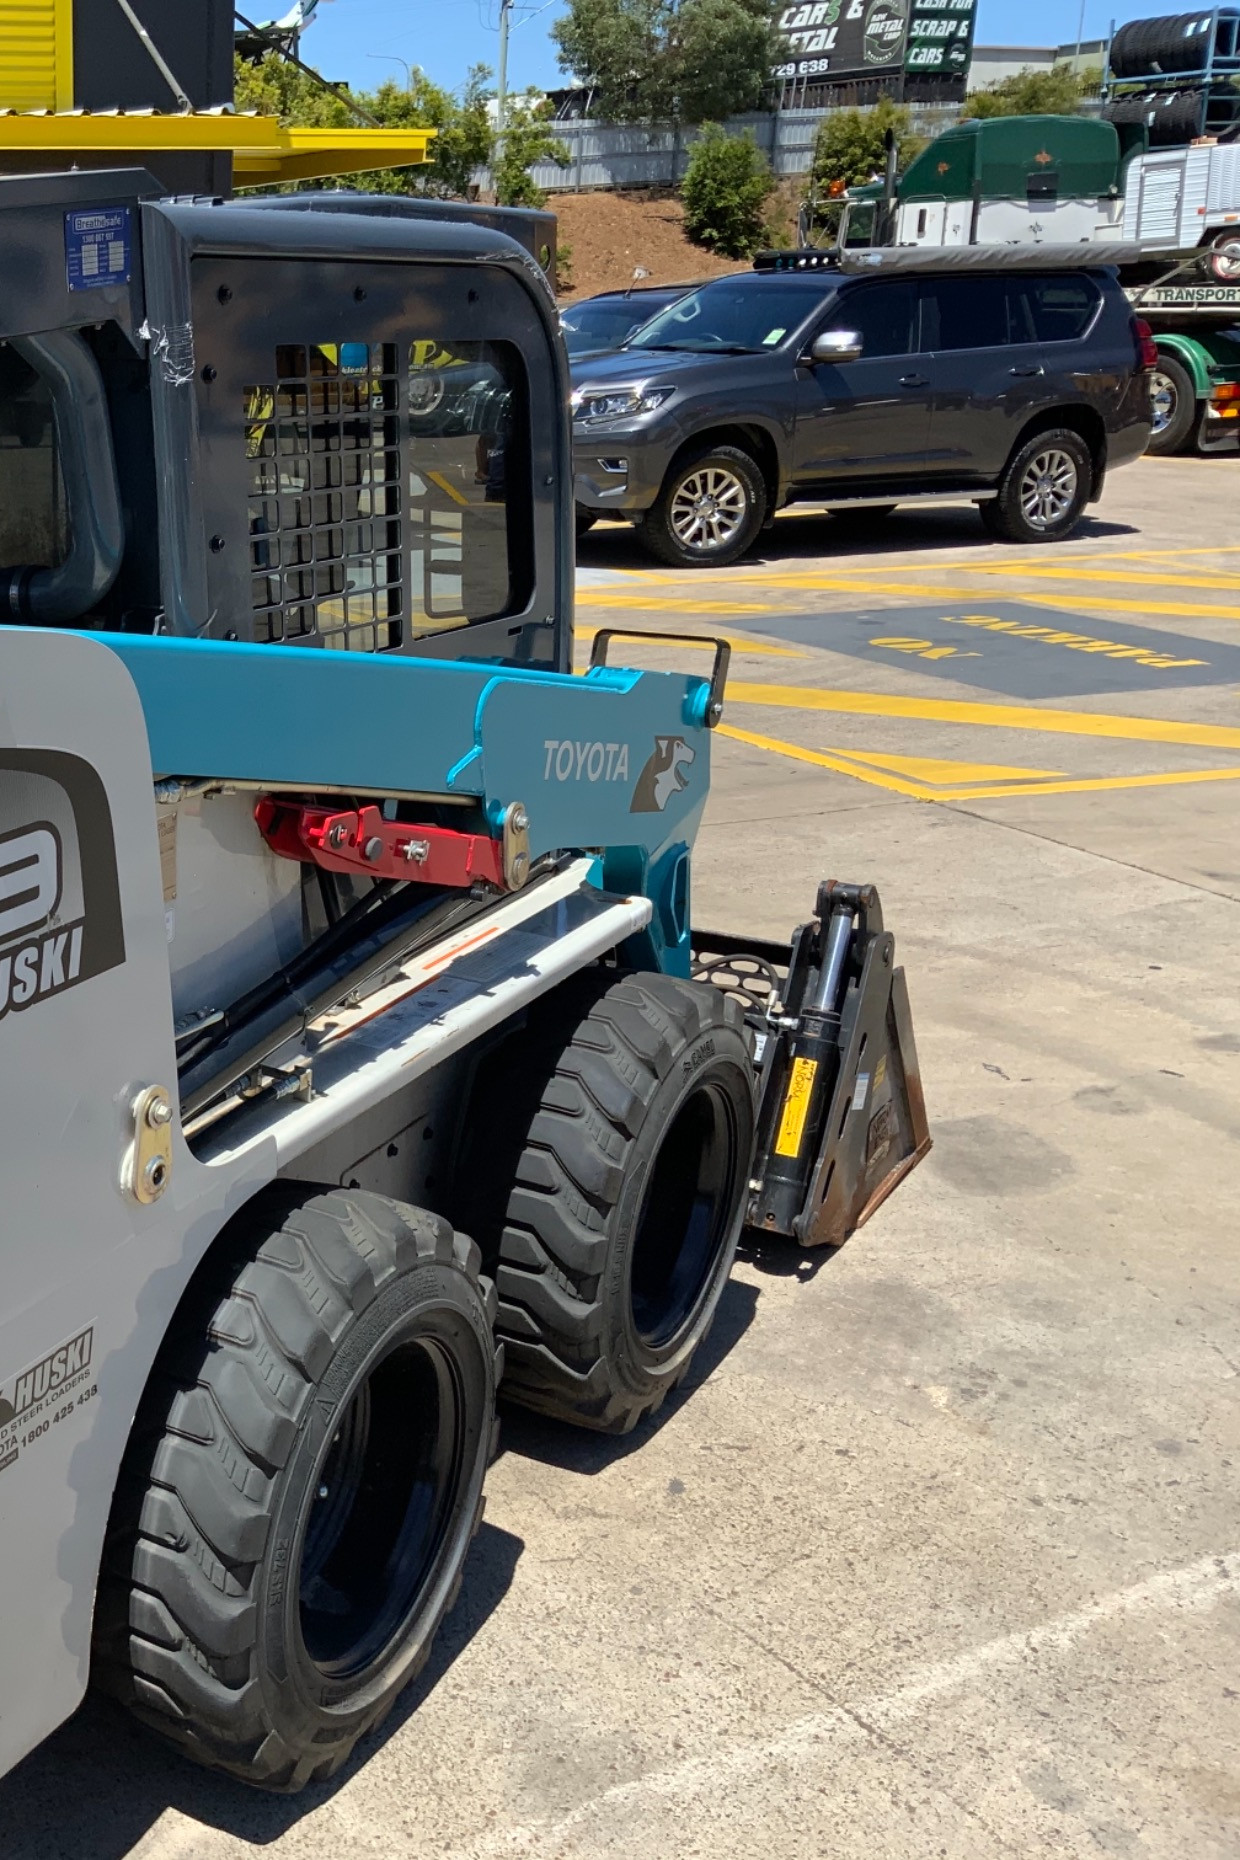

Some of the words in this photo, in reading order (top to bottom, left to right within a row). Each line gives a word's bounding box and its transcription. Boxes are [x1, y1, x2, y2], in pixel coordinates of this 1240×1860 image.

[866, 19, 904, 35] METAL
[910, 20, 957, 37] SCRAP
[908, 47, 945, 64] CARS
[544, 740, 629, 781] TOYOTA
[14, 1326, 93, 1414] HUSKI
[10, 1404, 44, 1432] STEER
[46, 1368, 91, 1407] LOADERS
[20, 1419, 50, 1448] 1800
[53, 1401, 75, 1425] 425
[77, 1384, 98, 1406] 438
